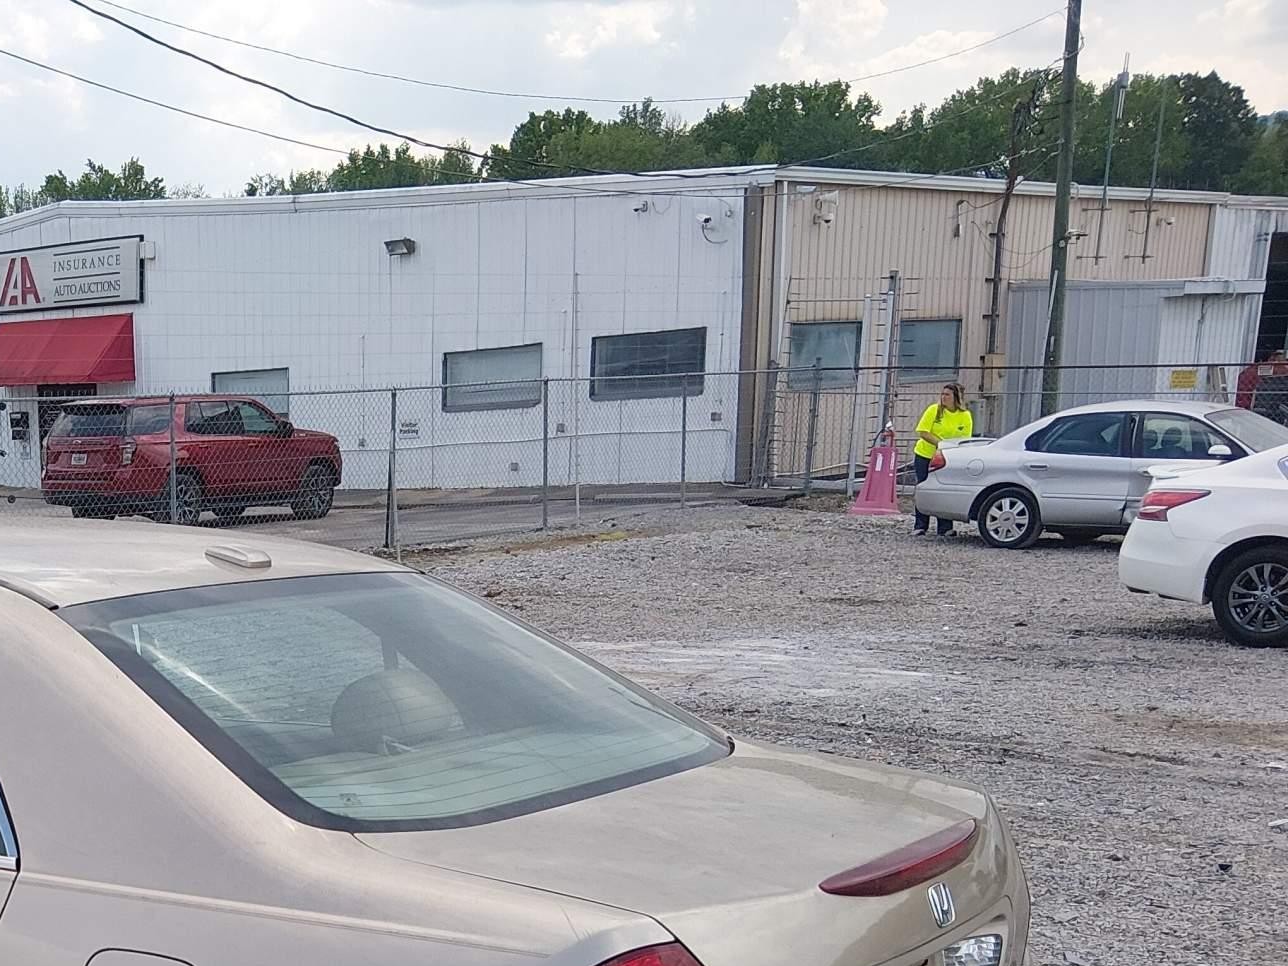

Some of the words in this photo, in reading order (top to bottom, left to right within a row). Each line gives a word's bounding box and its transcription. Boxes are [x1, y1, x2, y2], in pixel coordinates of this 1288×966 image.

[53, 254, 121, 273] INSURANCE
[53, 282, 77, 297] AUTO
[78, 279, 121, 294] AUCTIONS
